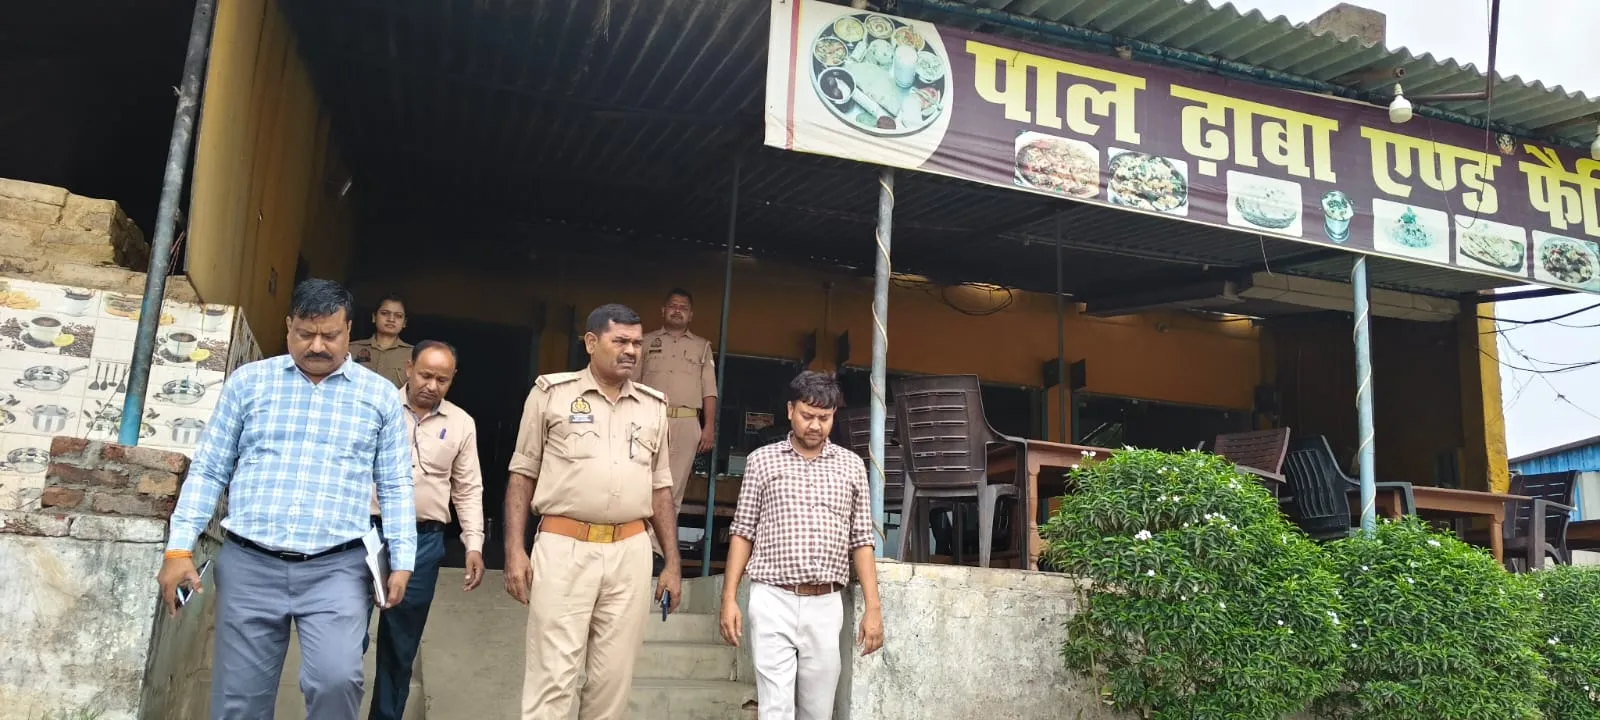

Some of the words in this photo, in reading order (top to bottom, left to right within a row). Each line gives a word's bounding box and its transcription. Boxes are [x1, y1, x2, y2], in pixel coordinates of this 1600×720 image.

[966, 40, 1147, 145] पाल
[1170, 84, 1339, 183] ढाबा
[1360, 126, 1502, 215] एण्ड
